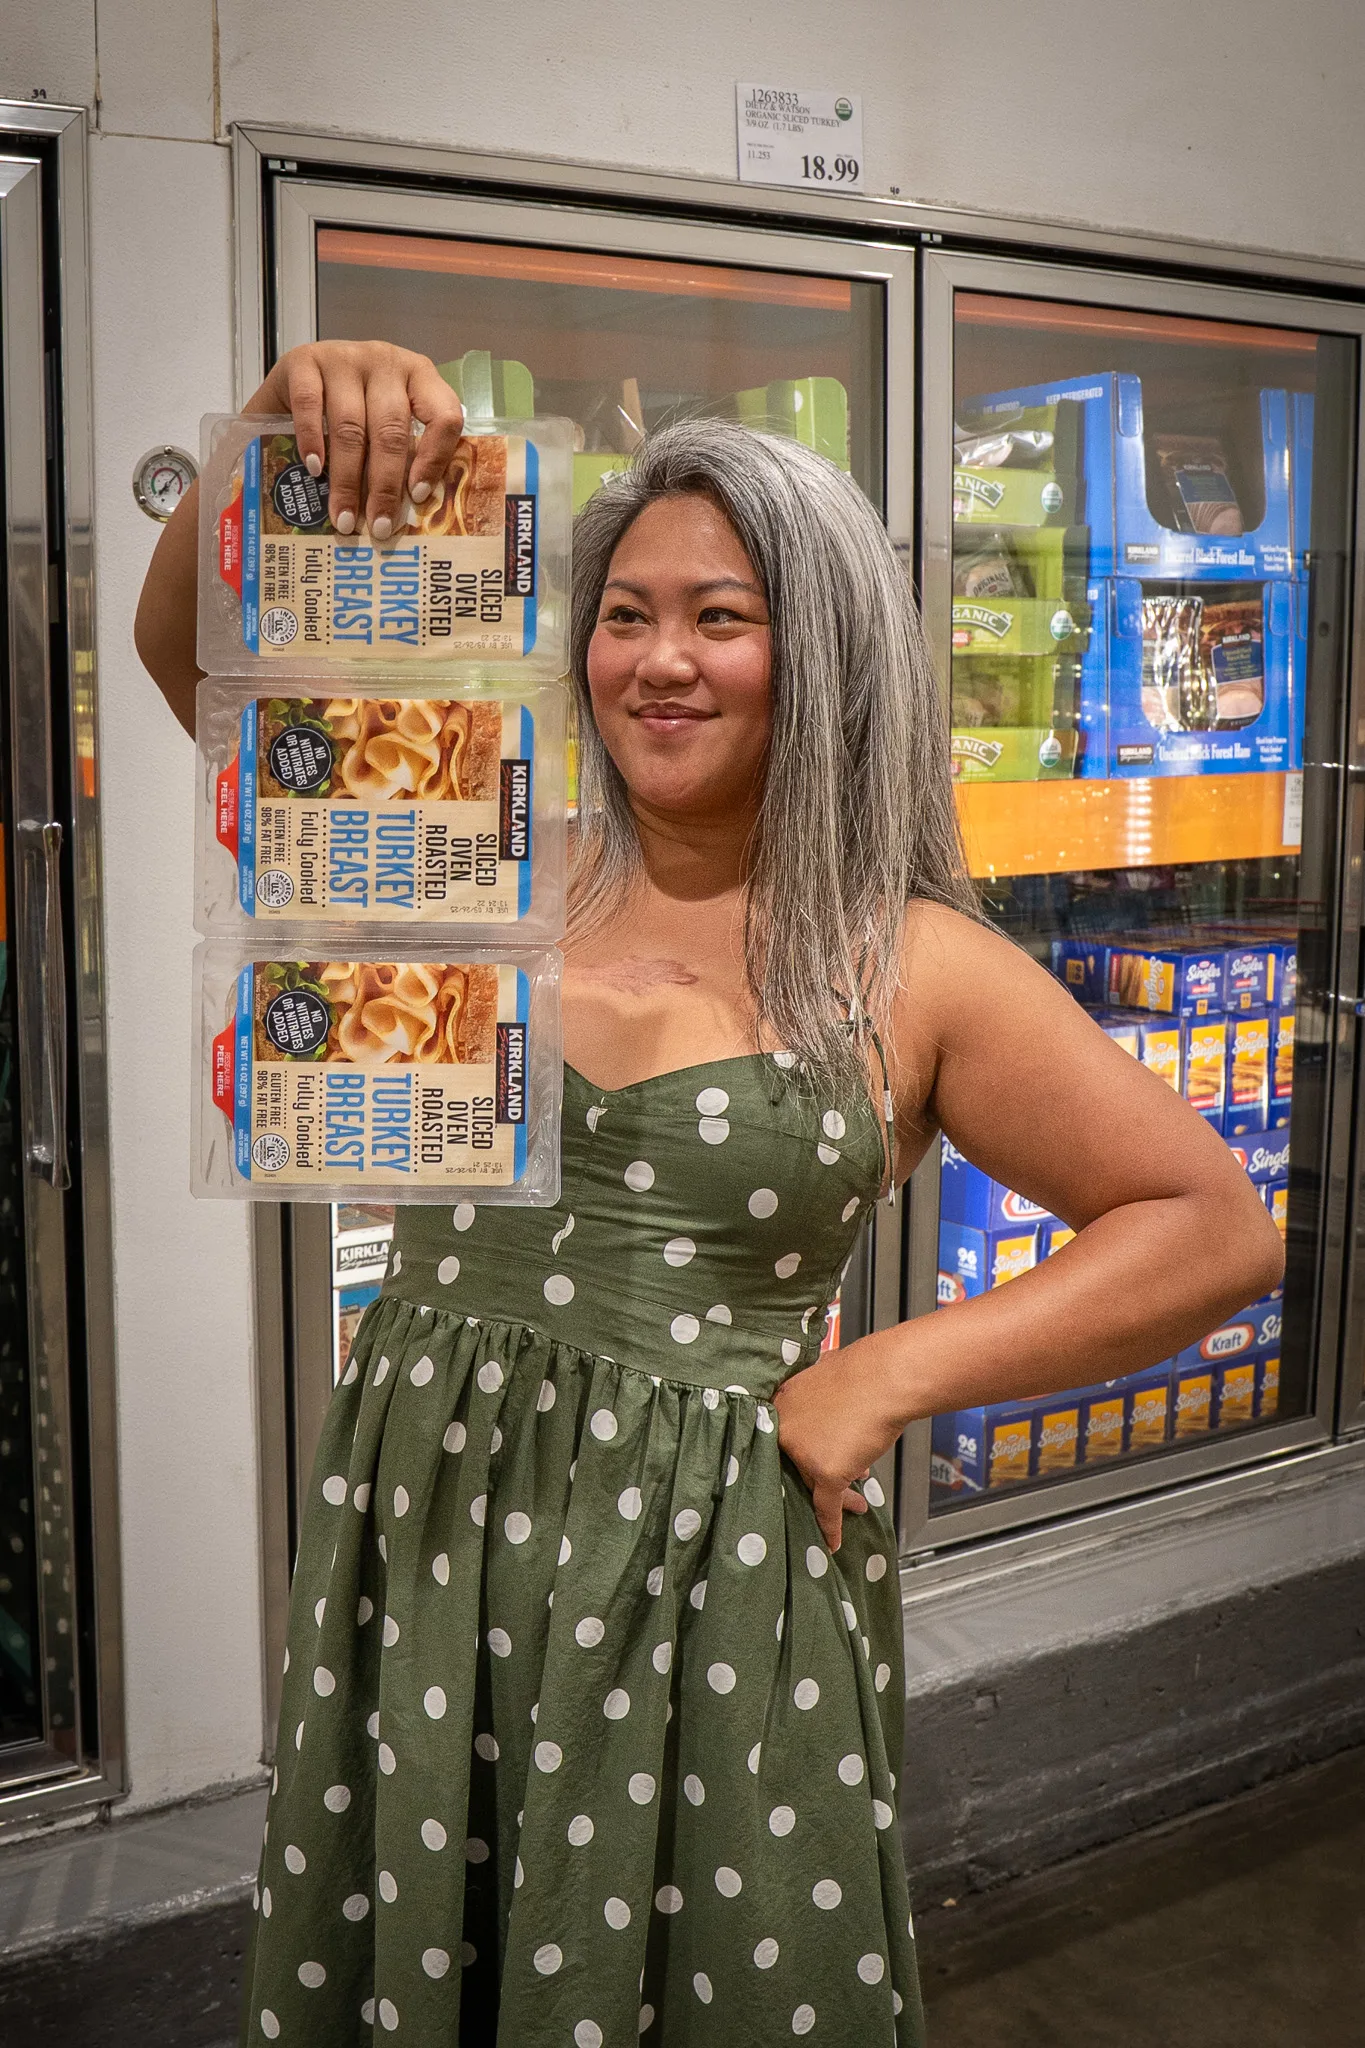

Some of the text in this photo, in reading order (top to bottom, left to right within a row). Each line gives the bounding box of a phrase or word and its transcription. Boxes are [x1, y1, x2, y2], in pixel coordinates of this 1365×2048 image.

[31, 88, 46, 99] 39
[752, 88, 798, 106] 1263833
[745, 100, 810, 114] DIETZ & WATSON
[745, 110, 840, 127] ORGANIC SLICED TURKEY
[758, 121, 768, 129] OZ
[788, 124, 804, 133] LBS)
[748, 150, 770, 160] 11.253
[801, 155, 859, 183] 18.99
[290, 471, 312, 522] OR NITRATES
[303, 476, 322, 512] NITRITES
[319, 483, 330, 495] NO
[954, 476, 991, 496] ANIC
[280, 485, 296, 516] ADDED
[248, 523, 255, 535] WT
[248, 536, 255, 545] 14
[248, 546, 255, 555] OZ
[516, 501, 532, 593] KIRKLAND
[1127, 546, 1158, 555] KIRKLAND
[264, 544, 275, 563] 98%
[1217, 549, 1237, 564] Forest
[1239, 550, 1255, 565] Ham
[265, 566, 275, 579] FAT
[278, 546, 289, 599] GLUTEN FREE
[264, 583, 275, 601] FREE
[301, 548, 323, 641] Fully Cooked
[332, 546, 373, 645] BREAST
[379, 546, 420, 646] TURKEY
[430, 560, 452, 637] ROASTED
[455, 574, 477, 618] OVEN
[481, 569, 502, 623] SLICED
[275, 620, 283, 633] U.S.
[280, 610, 295, 641] INSPECTED
[953, 608, 998, 627] GANIC
[1222, 633, 1250, 643] KIRKLAND
[300, 738, 318, 776] NITRITES
[314, 746, 326, 759] NO
[951, 740, 988, 756] ANIC
[1120, 747, 1152, 756] KIRKLAND
[1212, 744, 1232, 759] Forest
[1234, 743, 1250, 758] Ham
[276, 748, 293, 779] ADDED
[286, 734, 307, 786] OR NITRATES
[245, 786, 252, 798] WT
[244, 809, 251, 818] OZ
[245, 800, 252, 808] 14
[511, 765, 527, 857] KIRKLAND
[261, 807, 272, 826] 98%
[261, 830, 271, 842] FAT
[274, 809, 285, 862] GLUTEN FREE
[261, 846, 271, 864] FREE
[297, 812, 318, 904] Fully Cooked
[329, 810, 369, 908] BREAST
[376, 810, 415, 909] TURKEY
[424, 825, 447, 900] ROASTED
[450, 838, 472, 882] OVEN
[476, 834, 497, 886] SLICED
[271, 882, 279, 896] U.S.
[276, 874, 291, 905] INSPECTED
[1186, 963, 1221, 984] Singles
[1230, 957, 1263, 978] Singles
[272, 1012, 289, 1042] ADDED
[282, 998, 304, 1049] OR NITRATES
[296, 1002, 314, 1039] NITRITES
[311, 1010, 322, 1023] NO
[241, 1050, 248, 1061] WT
[1187, 1042, 1226, 1063] Singles
[1232, 1035, 1269, 1057] Singles
[240, 1073, 248, 1082] OZ
[241, 1063, 248, 1071] 14
[508, 1028, 522, 1120] KIRKLAND
[257, 1071, 268, 1090] 98%
[257, 1093, 267, 1106] FAT
[270, 1073, 281, 1126] GLUTEN FREE
[257, 1110, 267, 1128] FREE
[293, 1075, 314, 1168] Fully Cooked
[325, 1073, 365, 1171] BREAST
[372, 1073, 411, 1172] TURKEY
[422, 1088, 443, 1164] ROASTED
[447, 1101, 468, 1145] OVEN
[472, 1097, 493, 1150] SLICED
[267, 1146, 275, 1159] U.S.
[272, 1137, 287, 1168] INSPECTED
[1250, 1144, 1289, 1175] Singl
[340, 1242, 389, 1261] KIRKLA
[957, 1247, 977, 1266] 96
[1211, 1333, 1242, 1352] Kraft
[1174, 1390, 1212, 1412] Singles
[1130, 1403, 1167, 1425] Singles
[1038, 1426, 1079, 1448] Singles
[1085, 1416, 1124, 1438] Singles
[958, 1434, 977, 1452] 96
[990, 1438, 1032, 1460] Singles
[932, 1462, 950, 1480] aft
